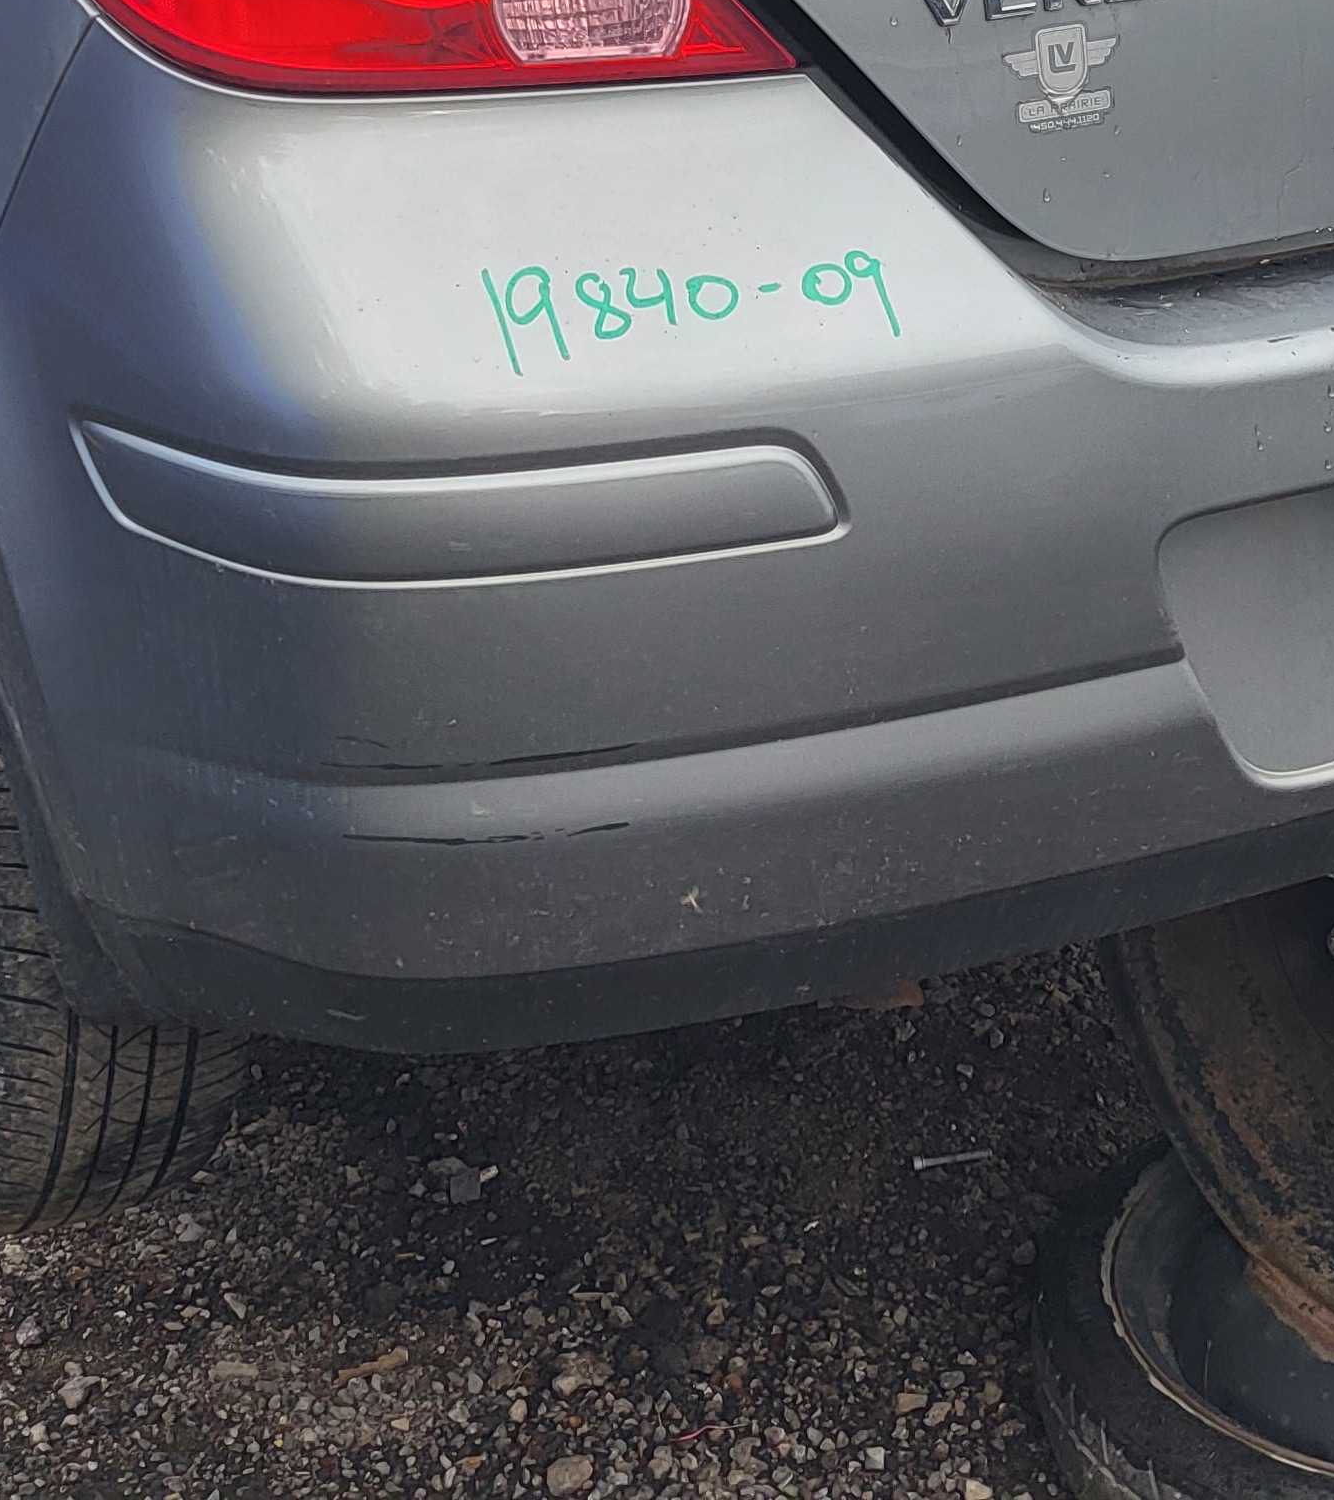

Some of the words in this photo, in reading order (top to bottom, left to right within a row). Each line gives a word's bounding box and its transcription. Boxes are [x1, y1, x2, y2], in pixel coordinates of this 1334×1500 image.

[1027, 104, 1044, 118] LA
[1051, 96, 1103, 115] PRAIRIE
[481, 250, 901, 377] 19840-09
